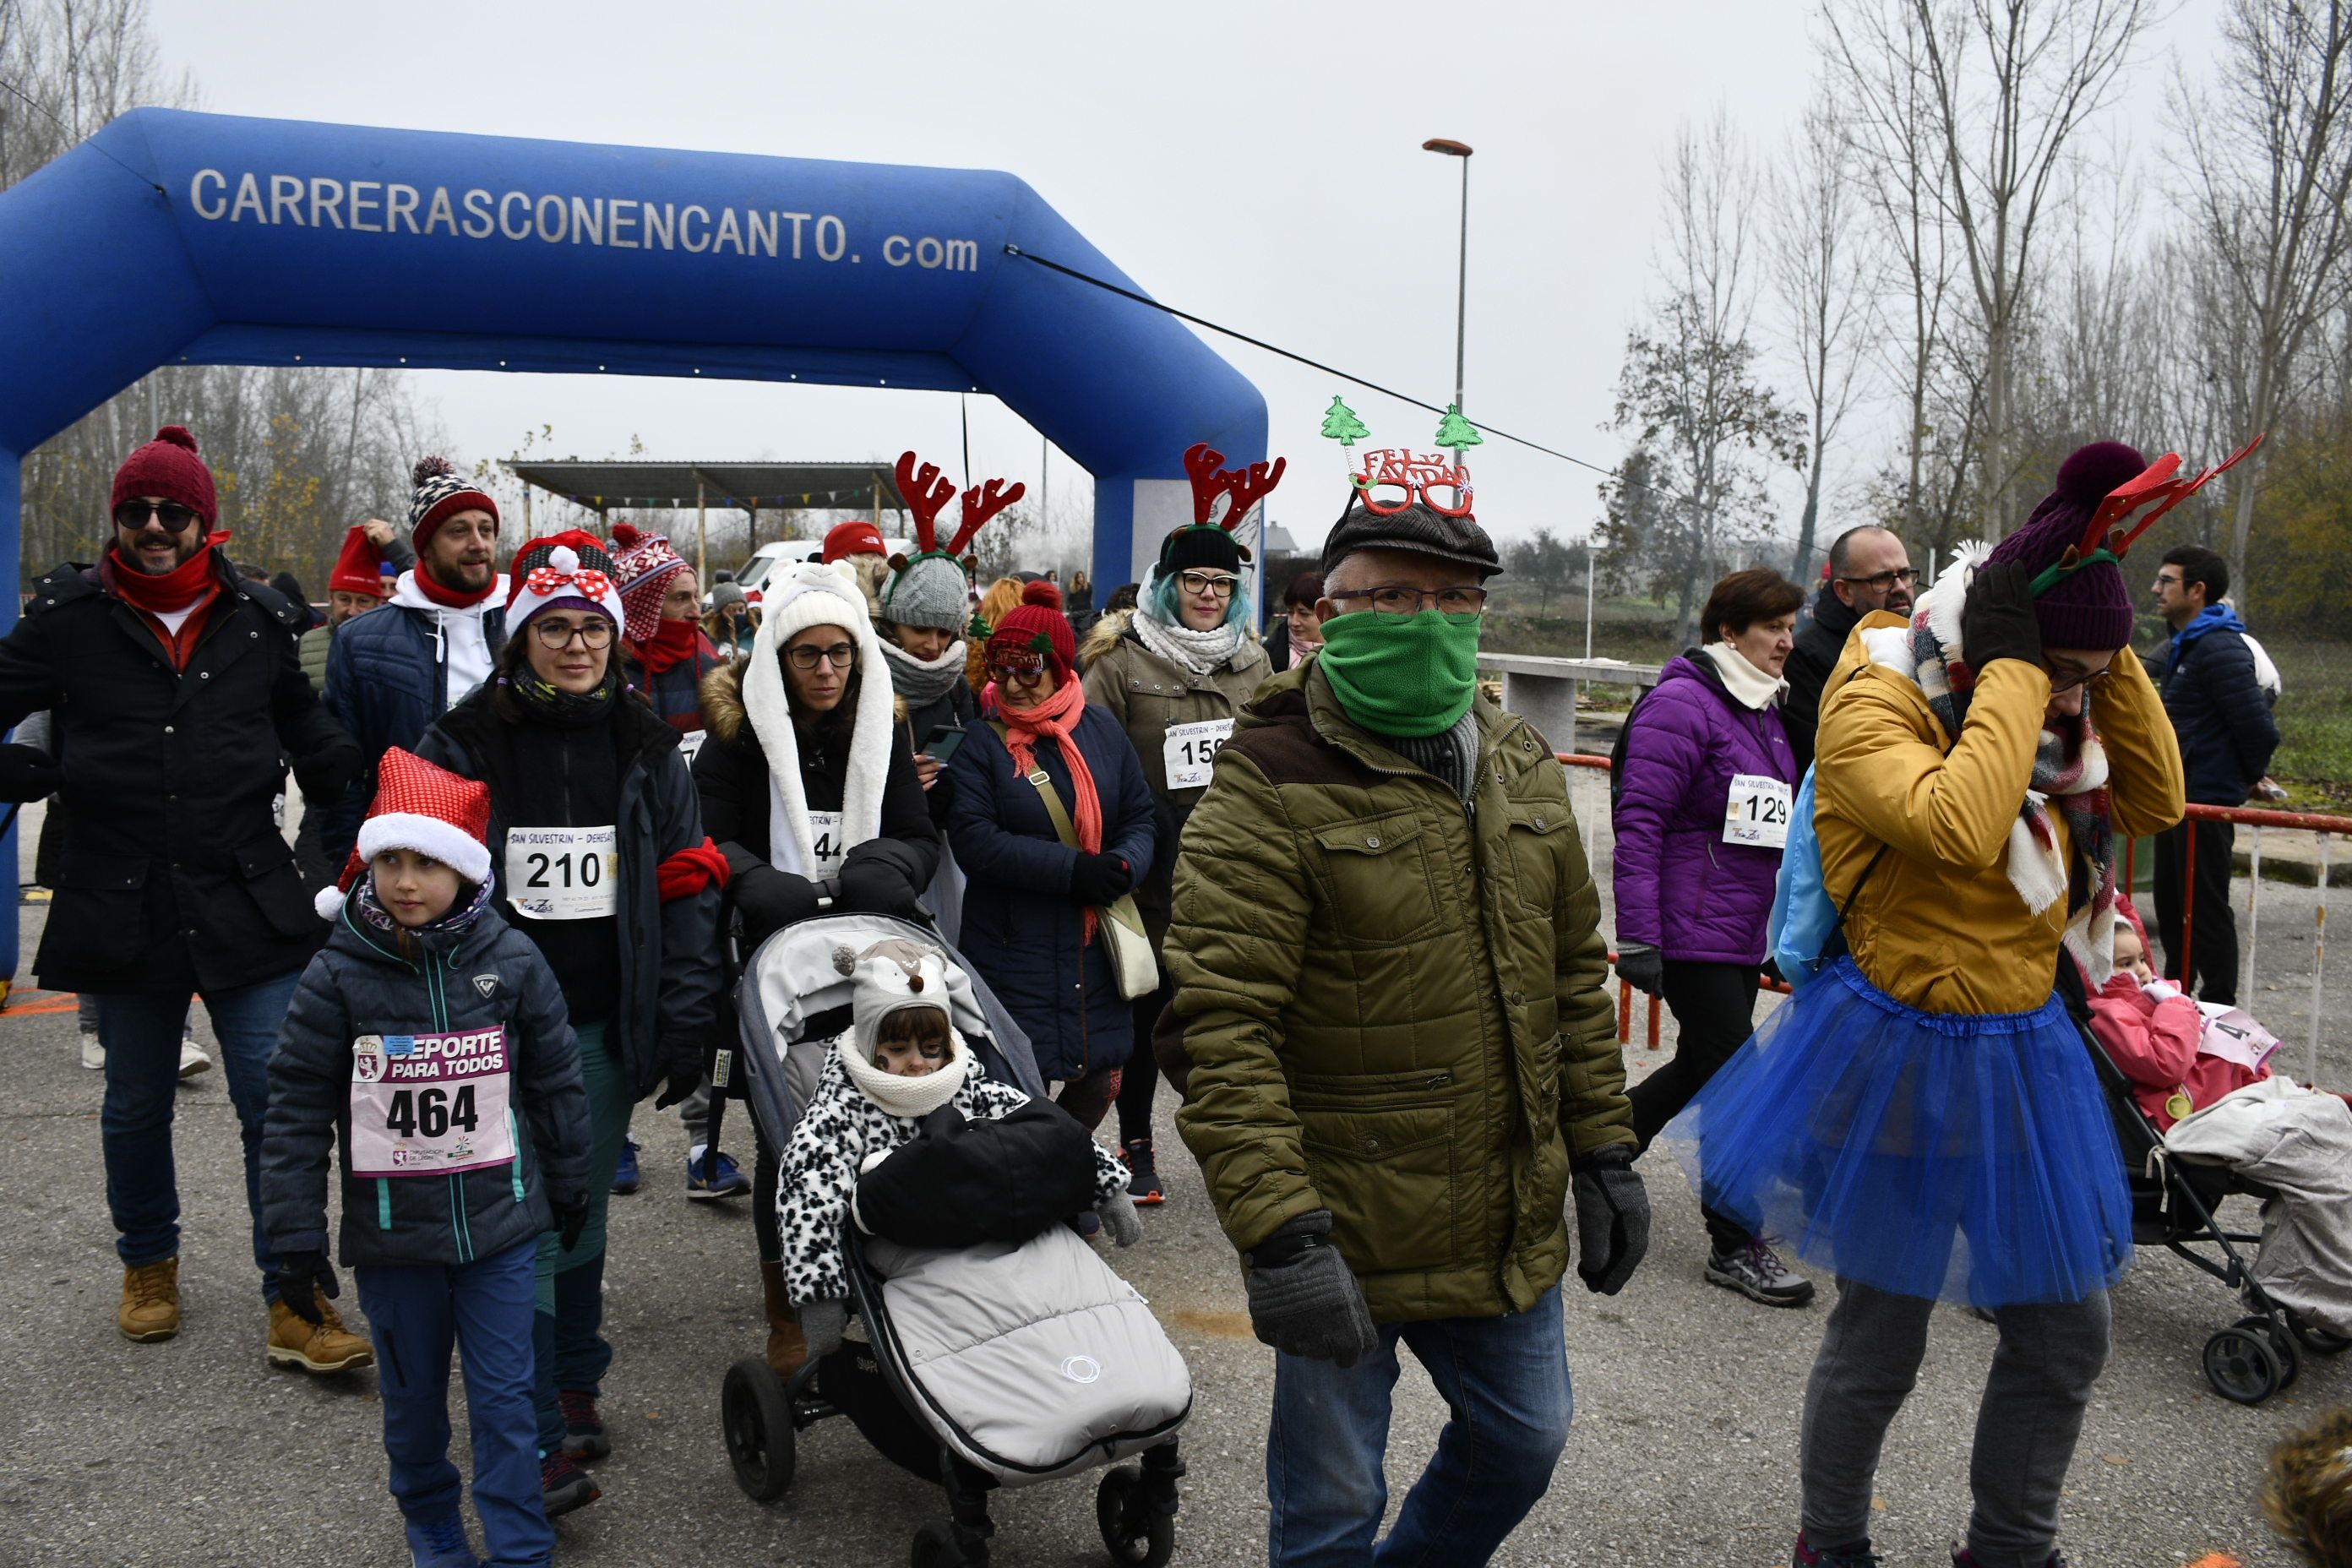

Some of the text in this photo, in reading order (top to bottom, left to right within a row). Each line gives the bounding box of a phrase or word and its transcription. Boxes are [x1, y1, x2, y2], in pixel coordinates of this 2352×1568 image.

[883, 235, 978, 272] com
[1364, 449, 1445, 468] FELIZ
[1747, 795, 1786, 825] 129
[511, 833, 525, 844] SAN
[529, 833, 574, 844] SILVESTRIN
[527, 852, 600, 888] 210
[390, 1031, 502, 1060] EPORTE
[391, 1054, 504, 1078] PARA TODOS
[387, 1085, 479, 1138] 464
